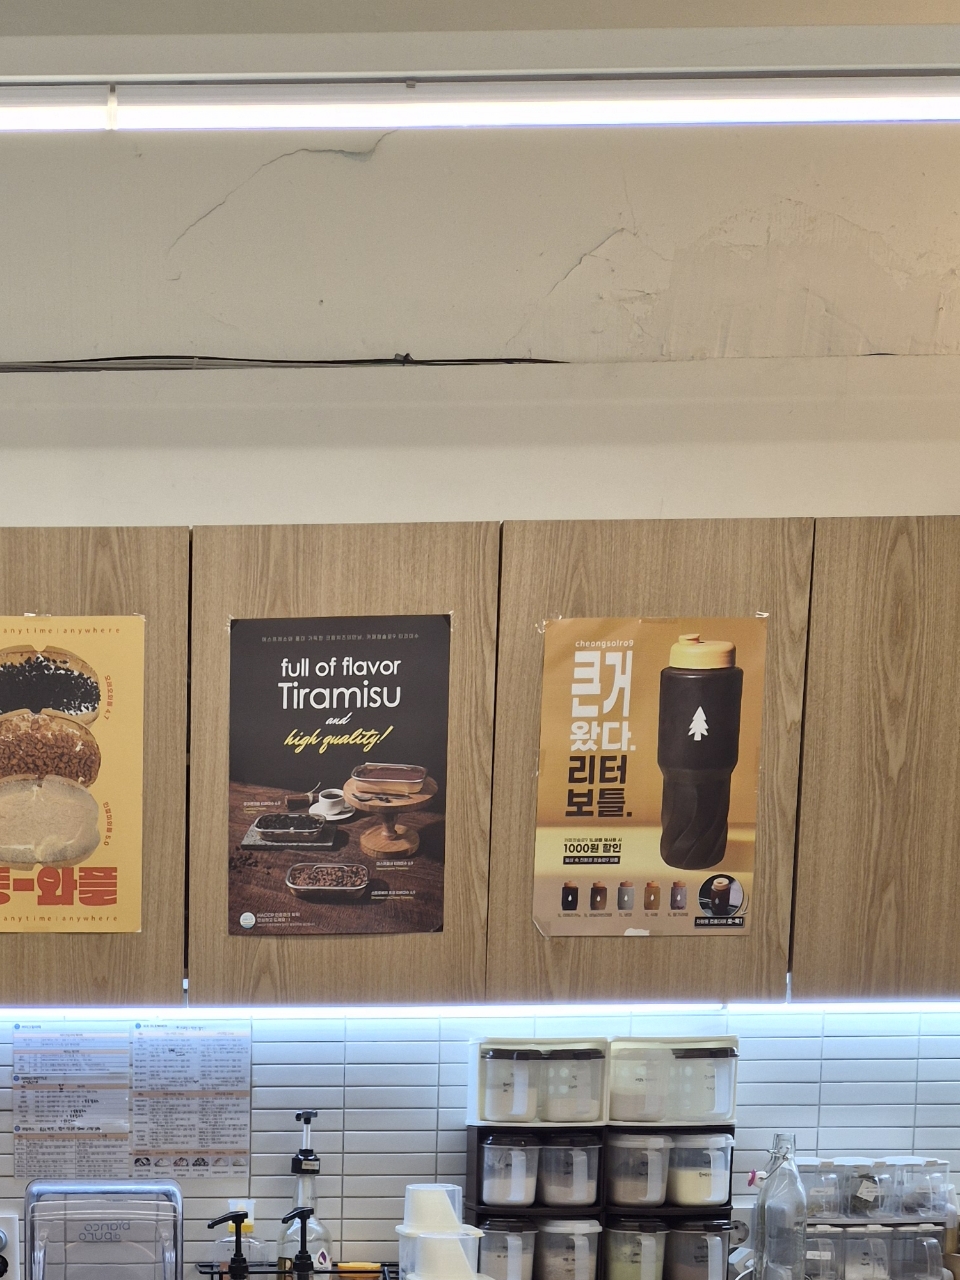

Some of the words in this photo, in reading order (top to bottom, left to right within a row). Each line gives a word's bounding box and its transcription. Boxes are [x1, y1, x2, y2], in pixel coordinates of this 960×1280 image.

[575, 639, 634, 648] cheongsolro9
[281, 658, 310, 677] full
[315, 657, 337, 676] of
[342, 656, 402, 676] flavor
[278, 680, 402, 710] Tiramisu
[571, 650, 634, 718] 큰거
[326, 712, 353, 725] and
[284, 728, 322, 754] high
[319, 726, 394, 754] quality!
[570, 720, 636, 752] 왔다.
[568, 755, 628, 785] 리터
[565, 788, 632, 818] 보틀.
[564, 843, 599, 854] 1000원
[602, 842, 622, 854] 할인
